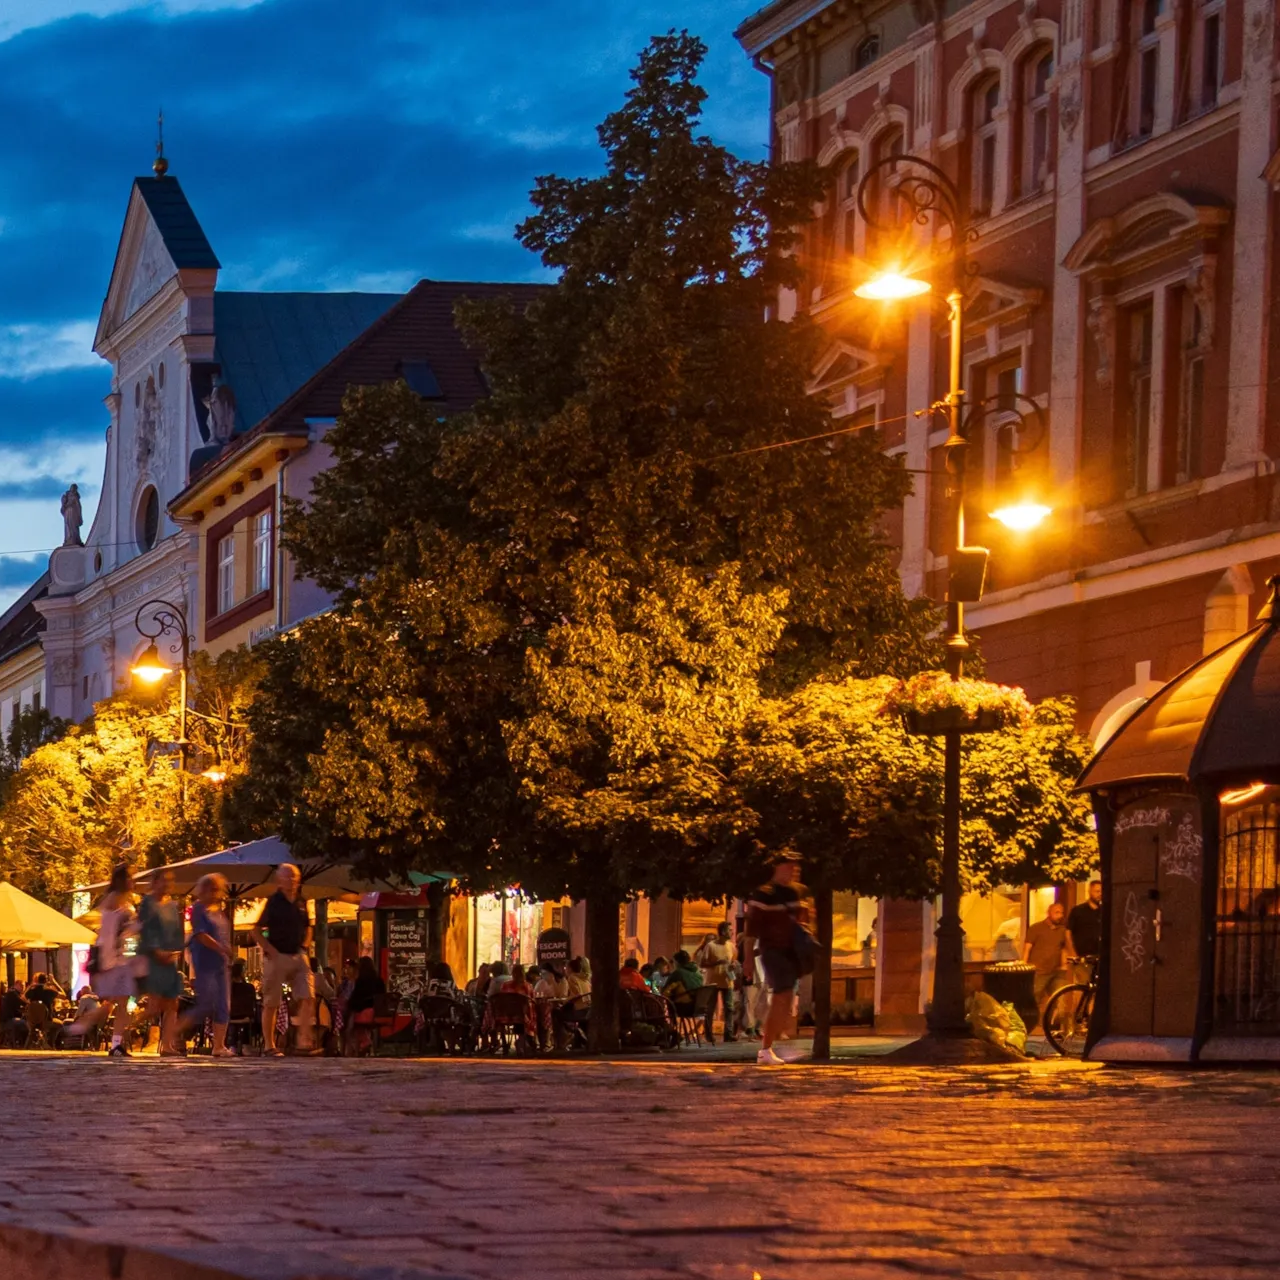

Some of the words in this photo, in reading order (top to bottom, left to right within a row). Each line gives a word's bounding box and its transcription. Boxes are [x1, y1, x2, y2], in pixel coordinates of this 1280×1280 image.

[390, 931, 407, 940] Káva
[408, 932, 420, 941] Čaj
[390, 940, 421, 948] Čokoláda
[539, 942, 567, 950] ESCAPE
[541, 951, 566, 959] ROOM
